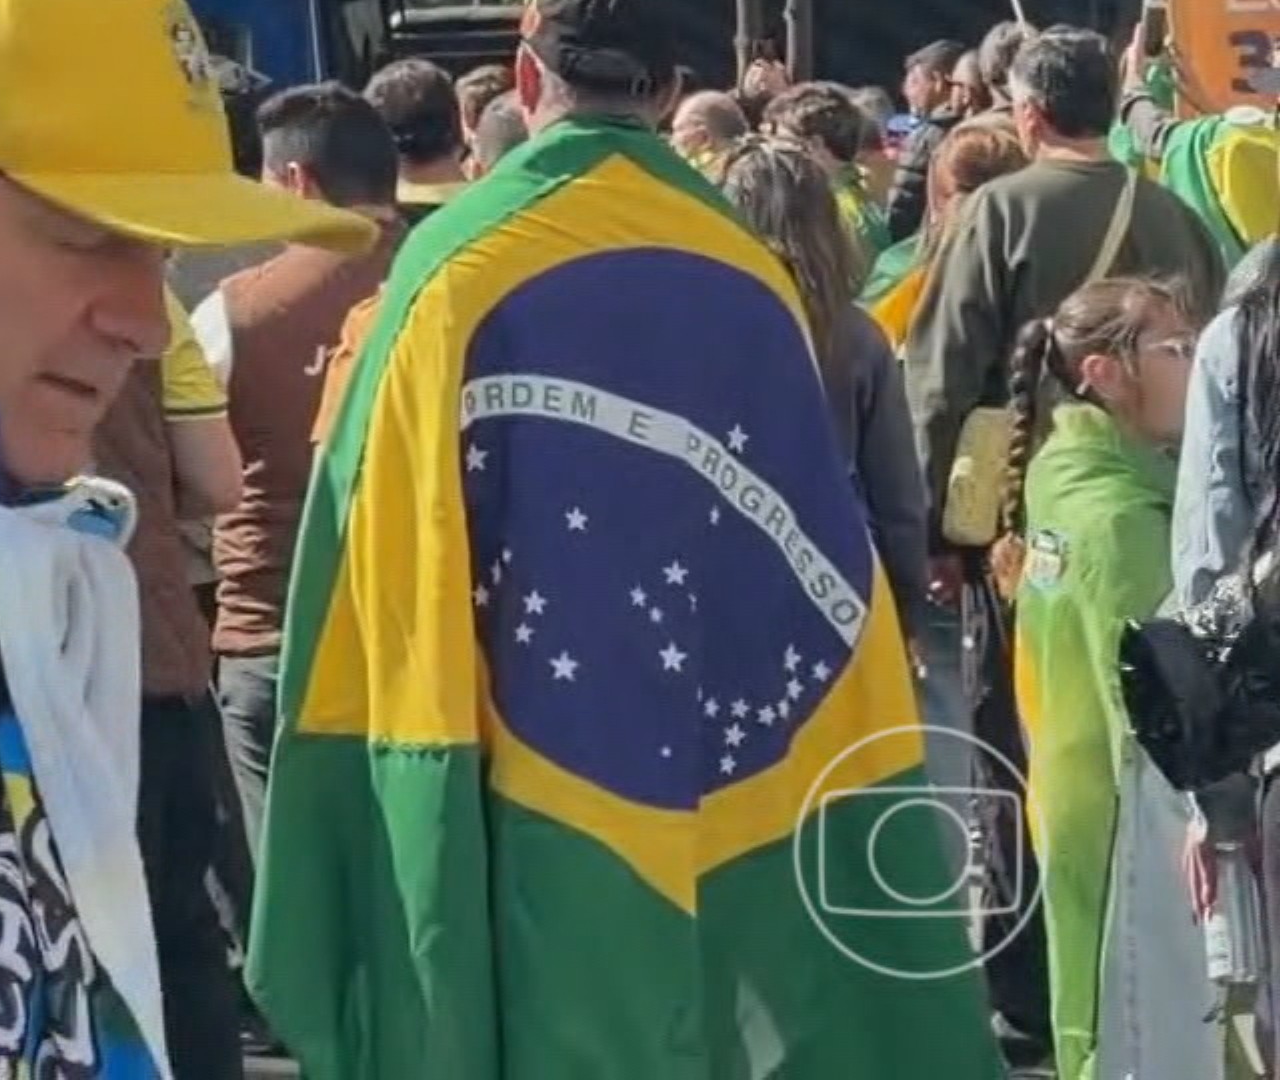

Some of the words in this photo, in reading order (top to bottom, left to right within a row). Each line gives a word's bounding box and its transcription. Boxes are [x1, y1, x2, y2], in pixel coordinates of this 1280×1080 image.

[464, 381, 597, 423] ORDEM
[628, 411, 651, 441] E
[685, 432, 859, 627] PROGRESSO
